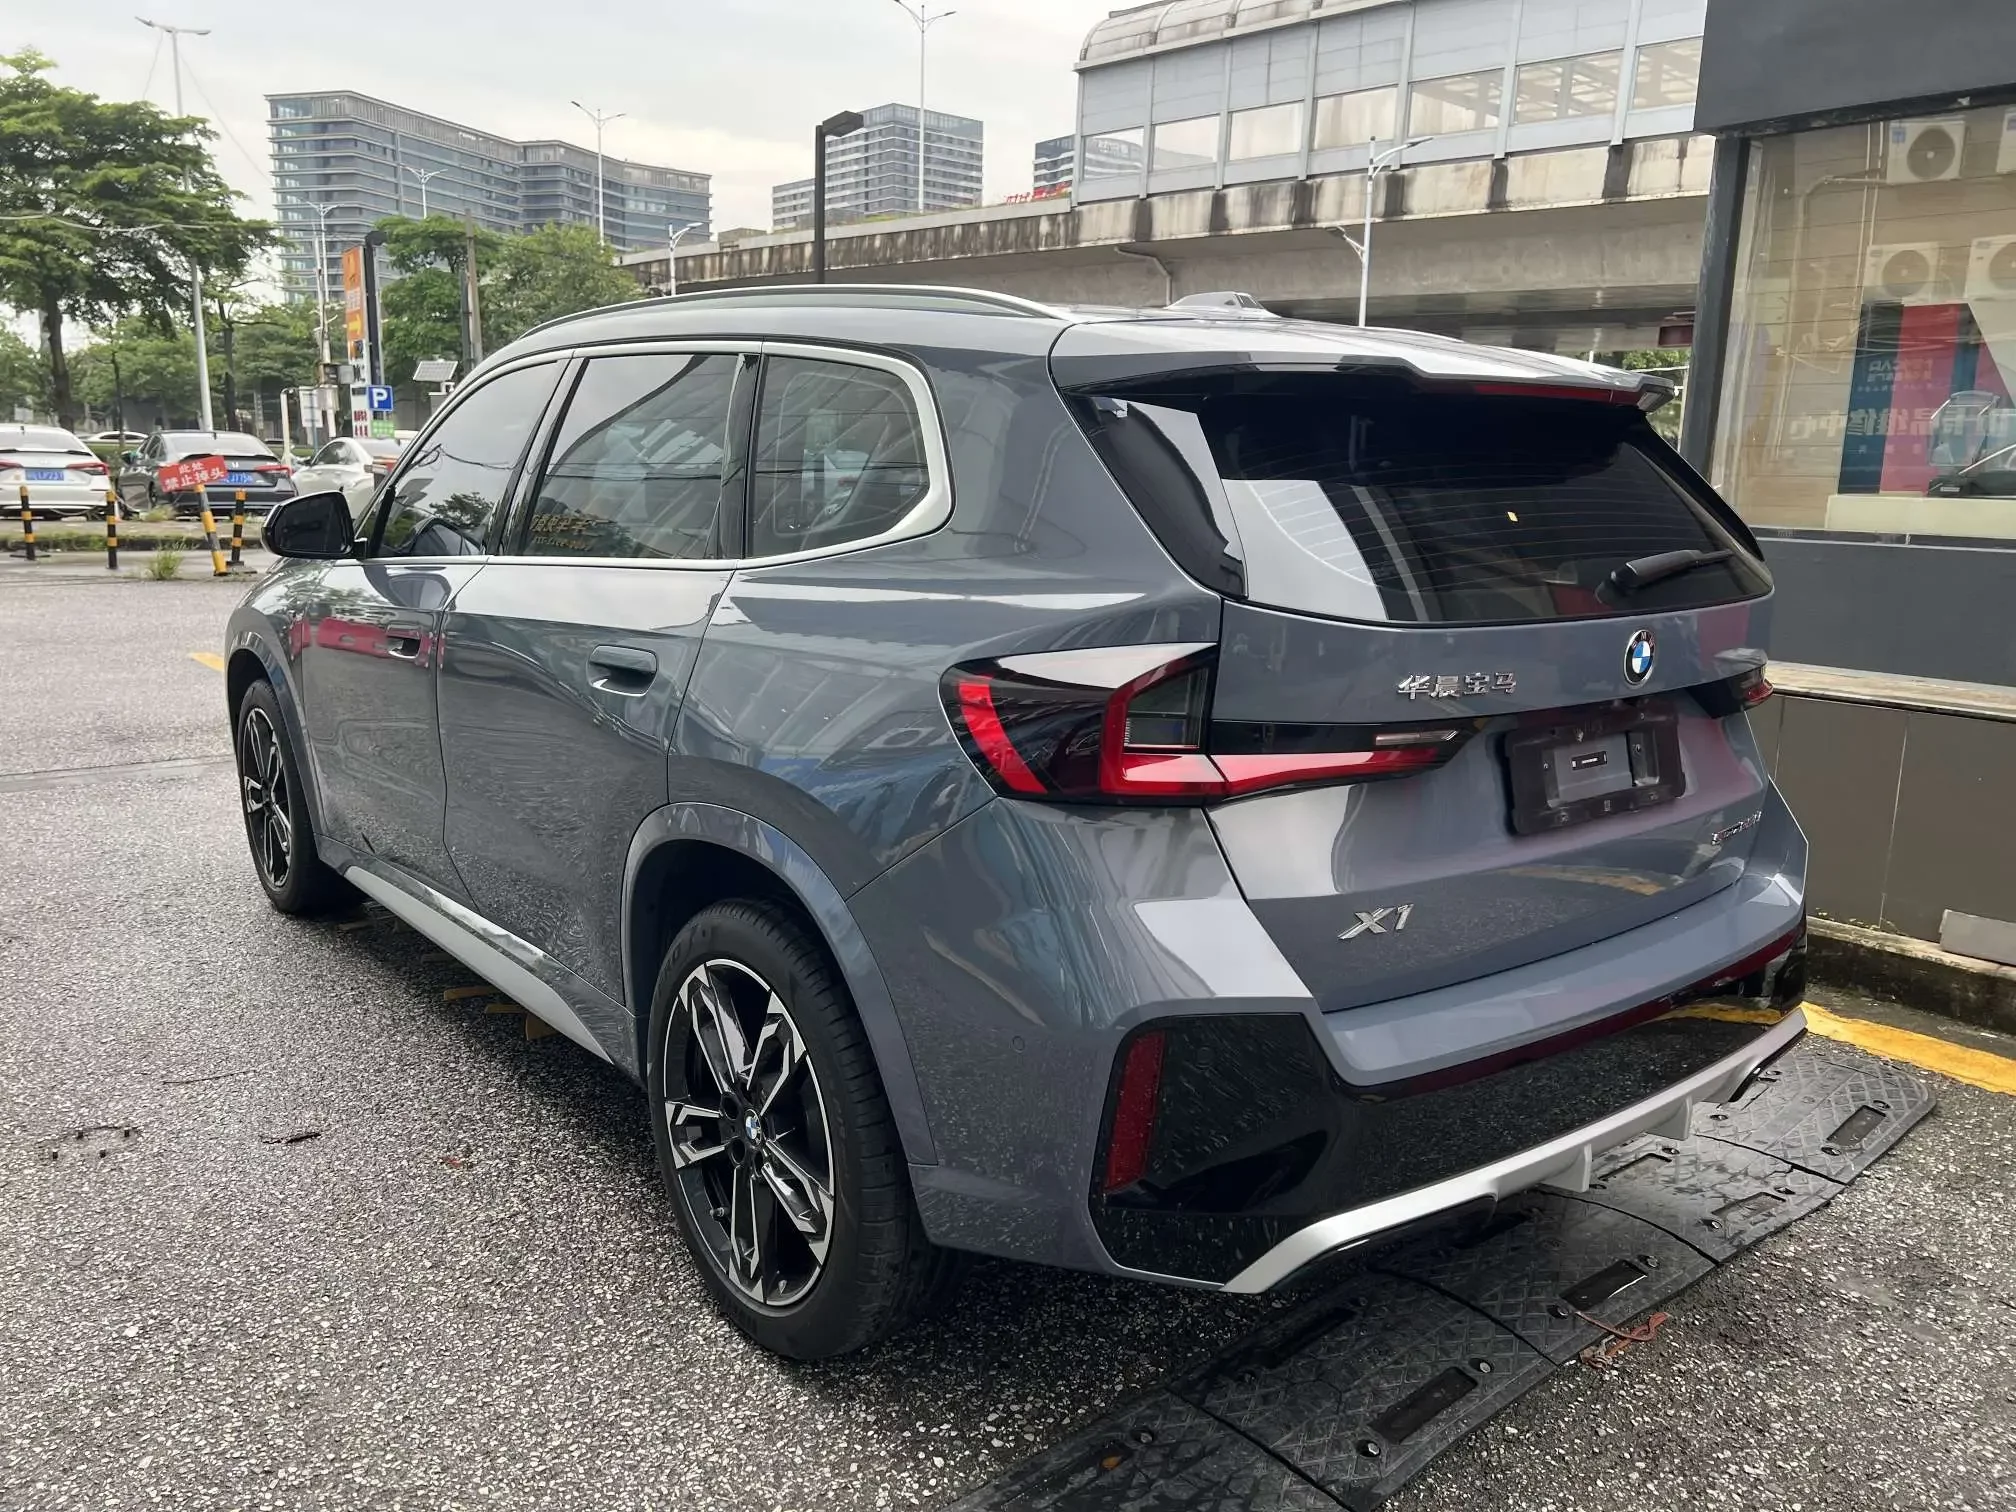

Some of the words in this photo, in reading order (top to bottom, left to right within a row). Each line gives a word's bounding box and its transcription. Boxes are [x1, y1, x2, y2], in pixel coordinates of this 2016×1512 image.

[371, 388, 388, 408] P
[178, 461, 205, 474] 此处
[164, 467, 225, 490] 禁止掉头
[1631, 631, 1656, 649] BMW
[1397, 672, 1517, 700] 华晨宝马
[1337, 903, 1415, 940] X1
